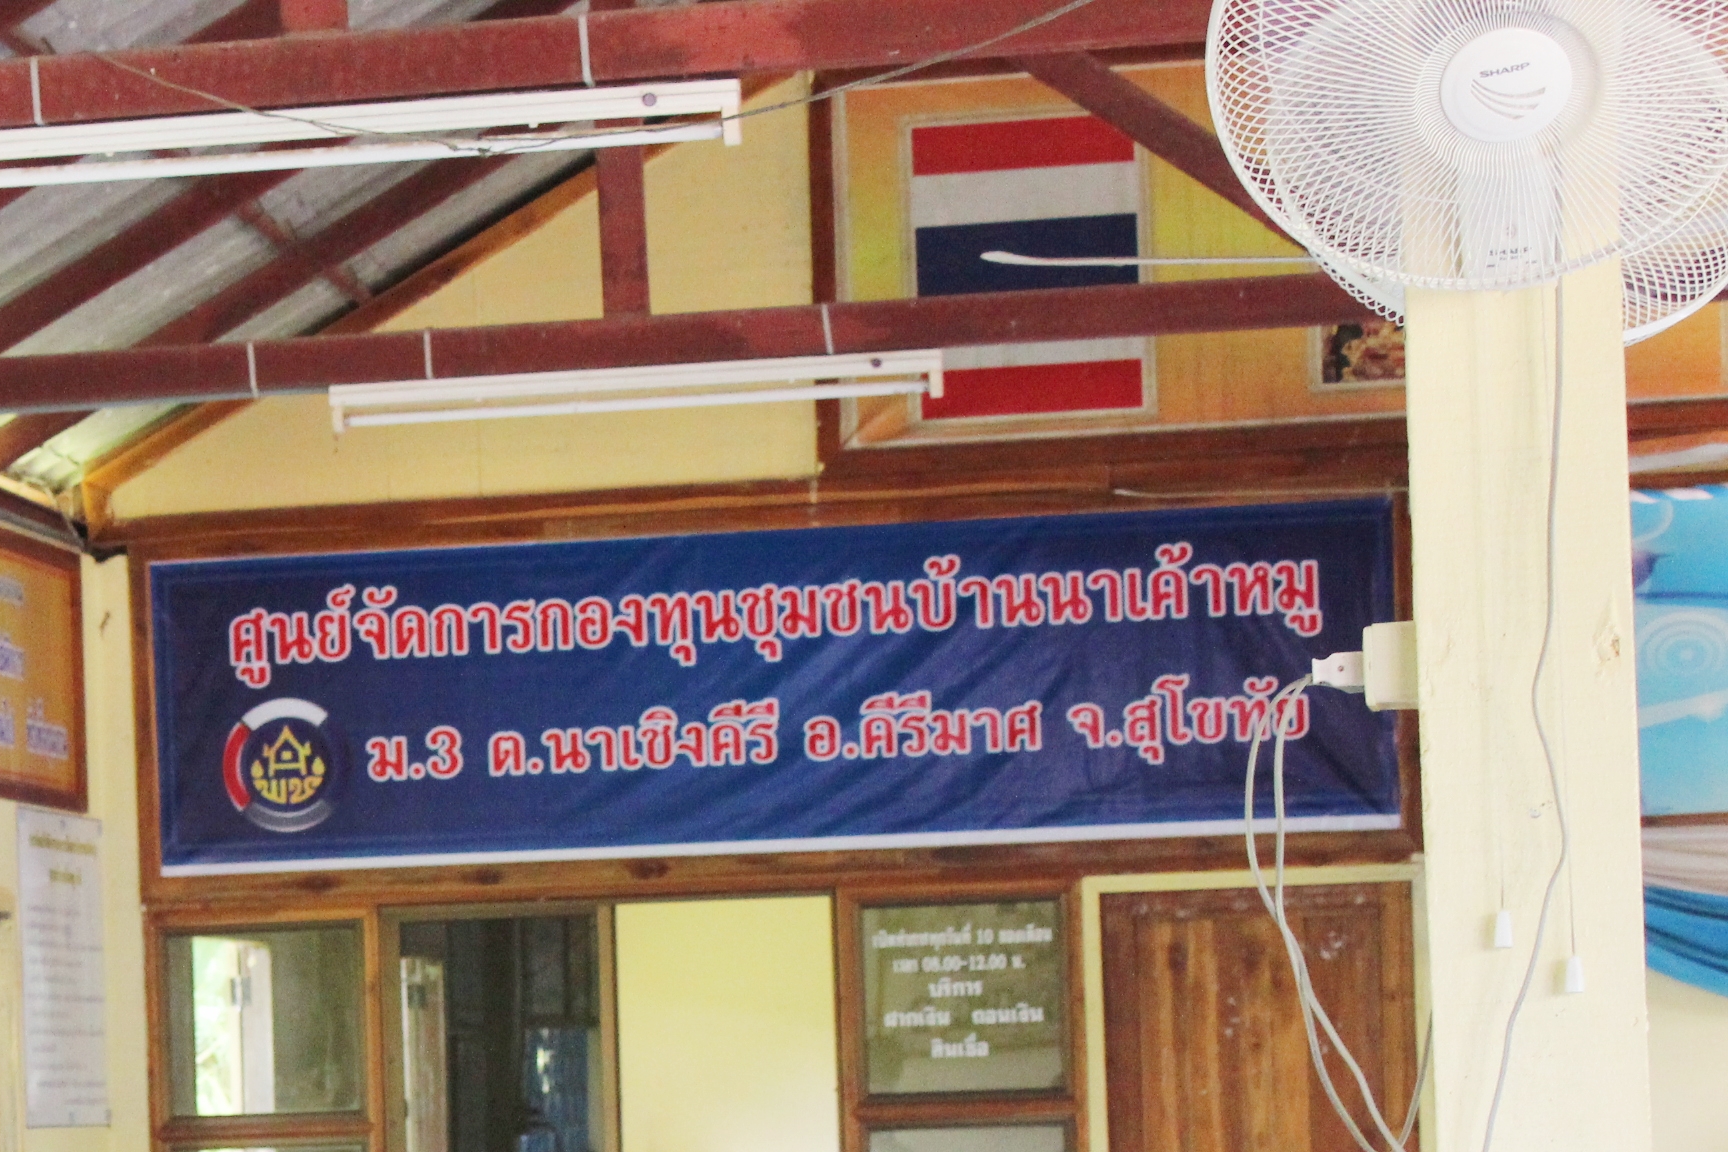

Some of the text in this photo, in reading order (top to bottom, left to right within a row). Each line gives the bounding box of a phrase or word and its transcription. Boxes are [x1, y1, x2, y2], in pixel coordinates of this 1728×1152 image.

[1479, 62, 1530, 78] SHARP
[229, 541, 1324, 689] ศูนย์จัดการกองทุนชุมชนบ้านนาเค้าหมู
[366, 674, 1312, 782] ม.3 ต.นาเชิงคีรี อ.คีรีมาศ จ.สุโขทัย
[976, 927, 994, 945] 10
[927, 977, 984, 998] บริการ
